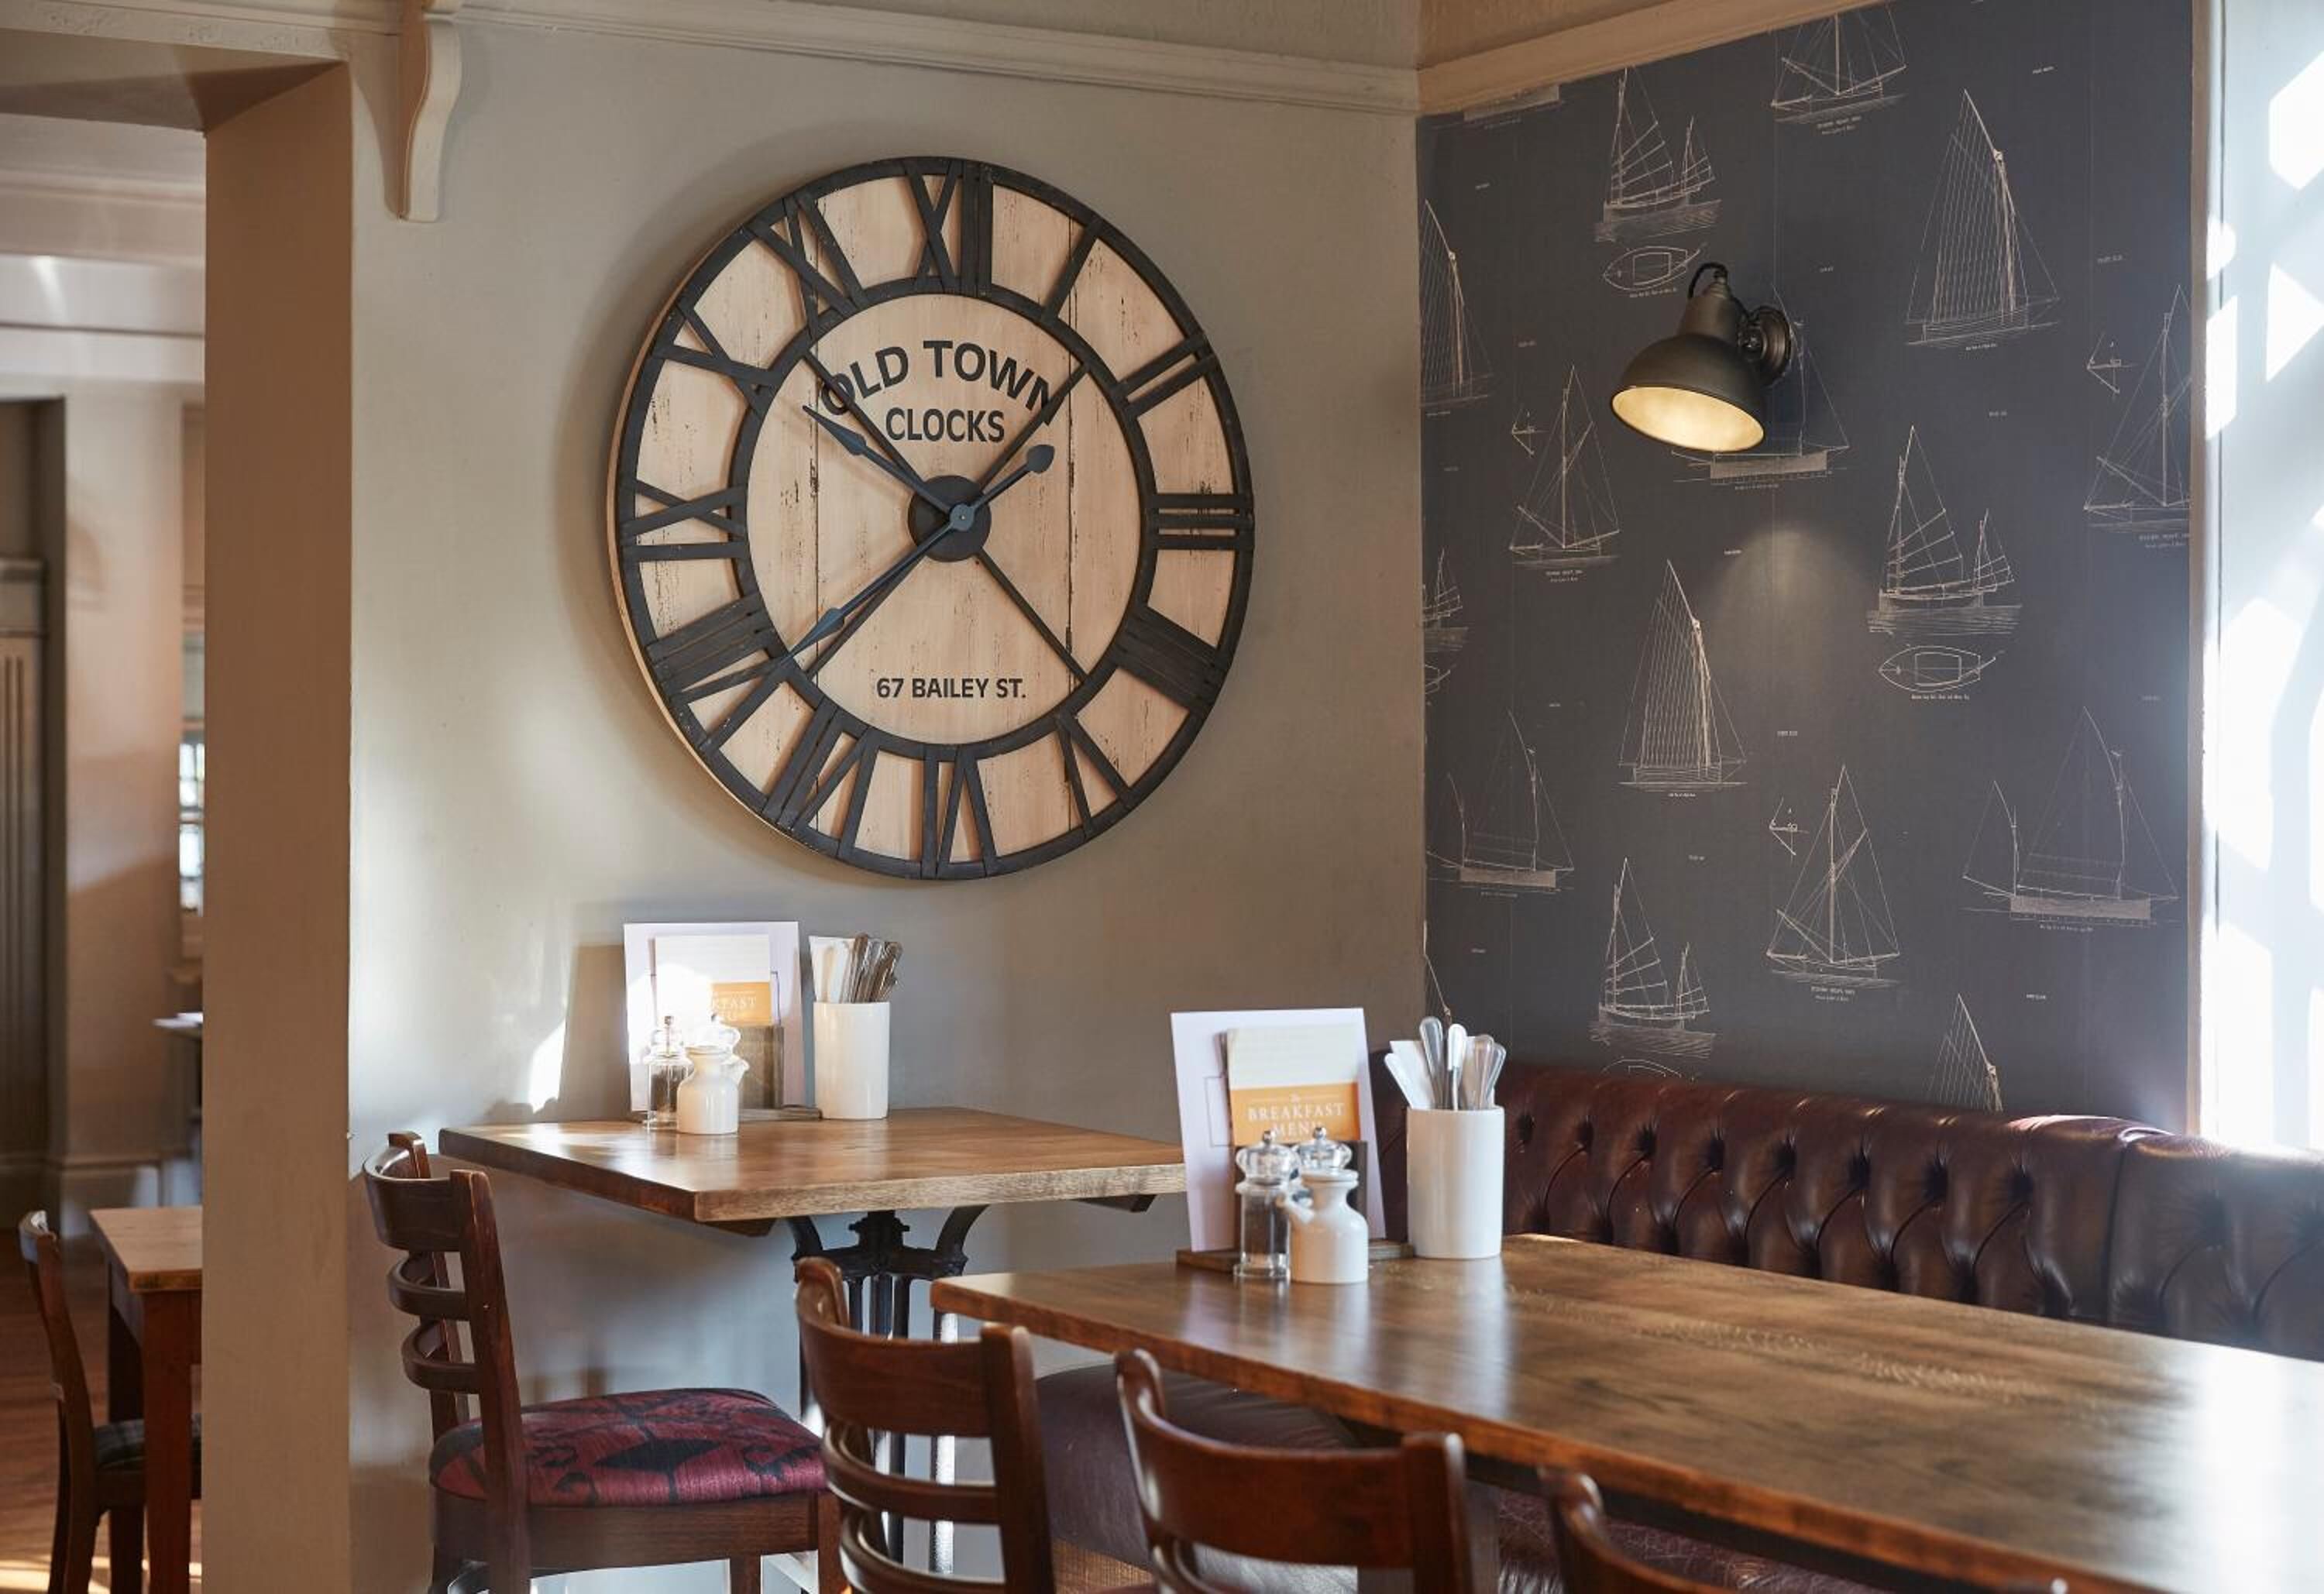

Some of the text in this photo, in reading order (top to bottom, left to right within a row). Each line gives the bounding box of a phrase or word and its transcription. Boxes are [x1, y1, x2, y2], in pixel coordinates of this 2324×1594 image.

[901, 159, 995, 294] XII
[1039, 209, 1105, 325] I
[658, 301, 781, 421] X
[820, 340, 1051, 426] OLD TOWN
[1111, 332, 1222, 418] II
[885, 407, 1005, 442] CLOCKS
[622, 478, 750, 562] IX
[1145, 493, 1253, 551] III
[876, 678, 1026, 698] 67 BAILEY ST.
[920, 744, 993, 878] VI
[1056, 714, 1133, 842] V
[1247, 1102, 1346, 1121] BREAKFAST
